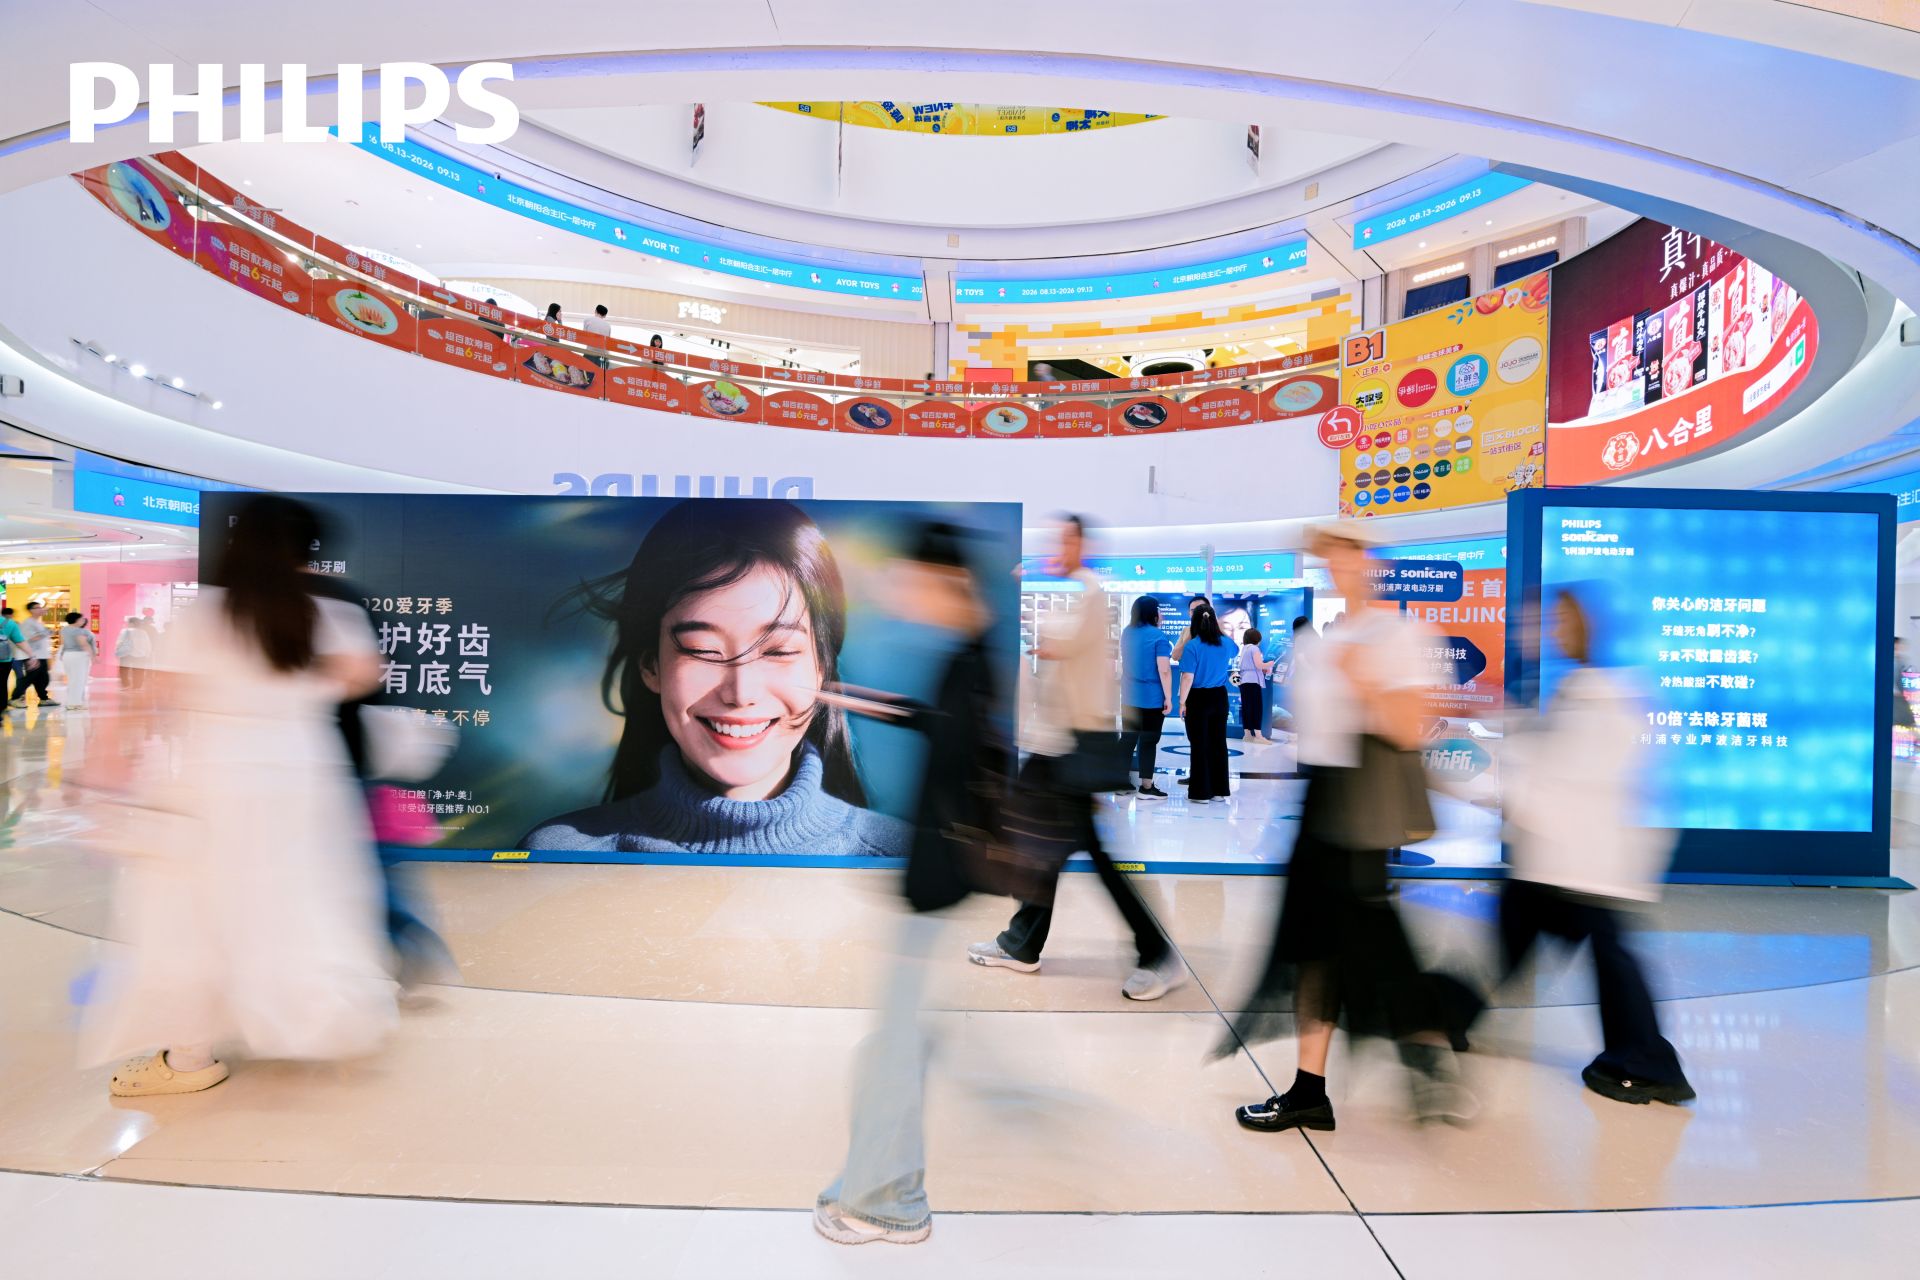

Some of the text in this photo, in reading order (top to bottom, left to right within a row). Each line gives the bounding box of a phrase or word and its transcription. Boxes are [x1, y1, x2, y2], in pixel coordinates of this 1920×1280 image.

[437, 165, 461, 182] 09.13
[1386, 188, 1482, 231] 2026 08.13-2026 09.13
[642, 237, 667, 251] AYOR
[836, 278, 880, 290] AYOR TOYS
[1021, 285, 1093, 296] 2026 08.13-2026 09.13
[964, 288, 985, 296] TOYS
[465, 300, 503, 321] B1西侧
[1347, 331, 1384, 366] B1
[643, 348, 675, 363] B1西侧
[796, 373, 825, 385] B1西侧
[1217, 367, 1248, 378] B1西侧
[935, 383, 963, 393] B1西侧
[1071, 383, 1100, 392] B1西侧
[1640, 404, 1713, 456] 八合里
[1561, 519, 1602, 529] PHILIPS
[1561, 530, 1619, 543] sonicare
[1561, 547, 1635, 556] 飞利浦声波电动牙刷
[1166, 566, 1184, 574] 2026
[1226, 565, 1245, 573] 09.13
[1362, 566, 1458, 579] HILIPS sonicare
[1652, 597, 1766, 613] 你关心的洁牙问题
[378, 622, 491, 657] 护好齿
[378, 660, 492, 696] 有底气
[1632, 733, 1788, 748] 利浦专业声波洁牙科技
[467, 805, 490, 814] NO.1
